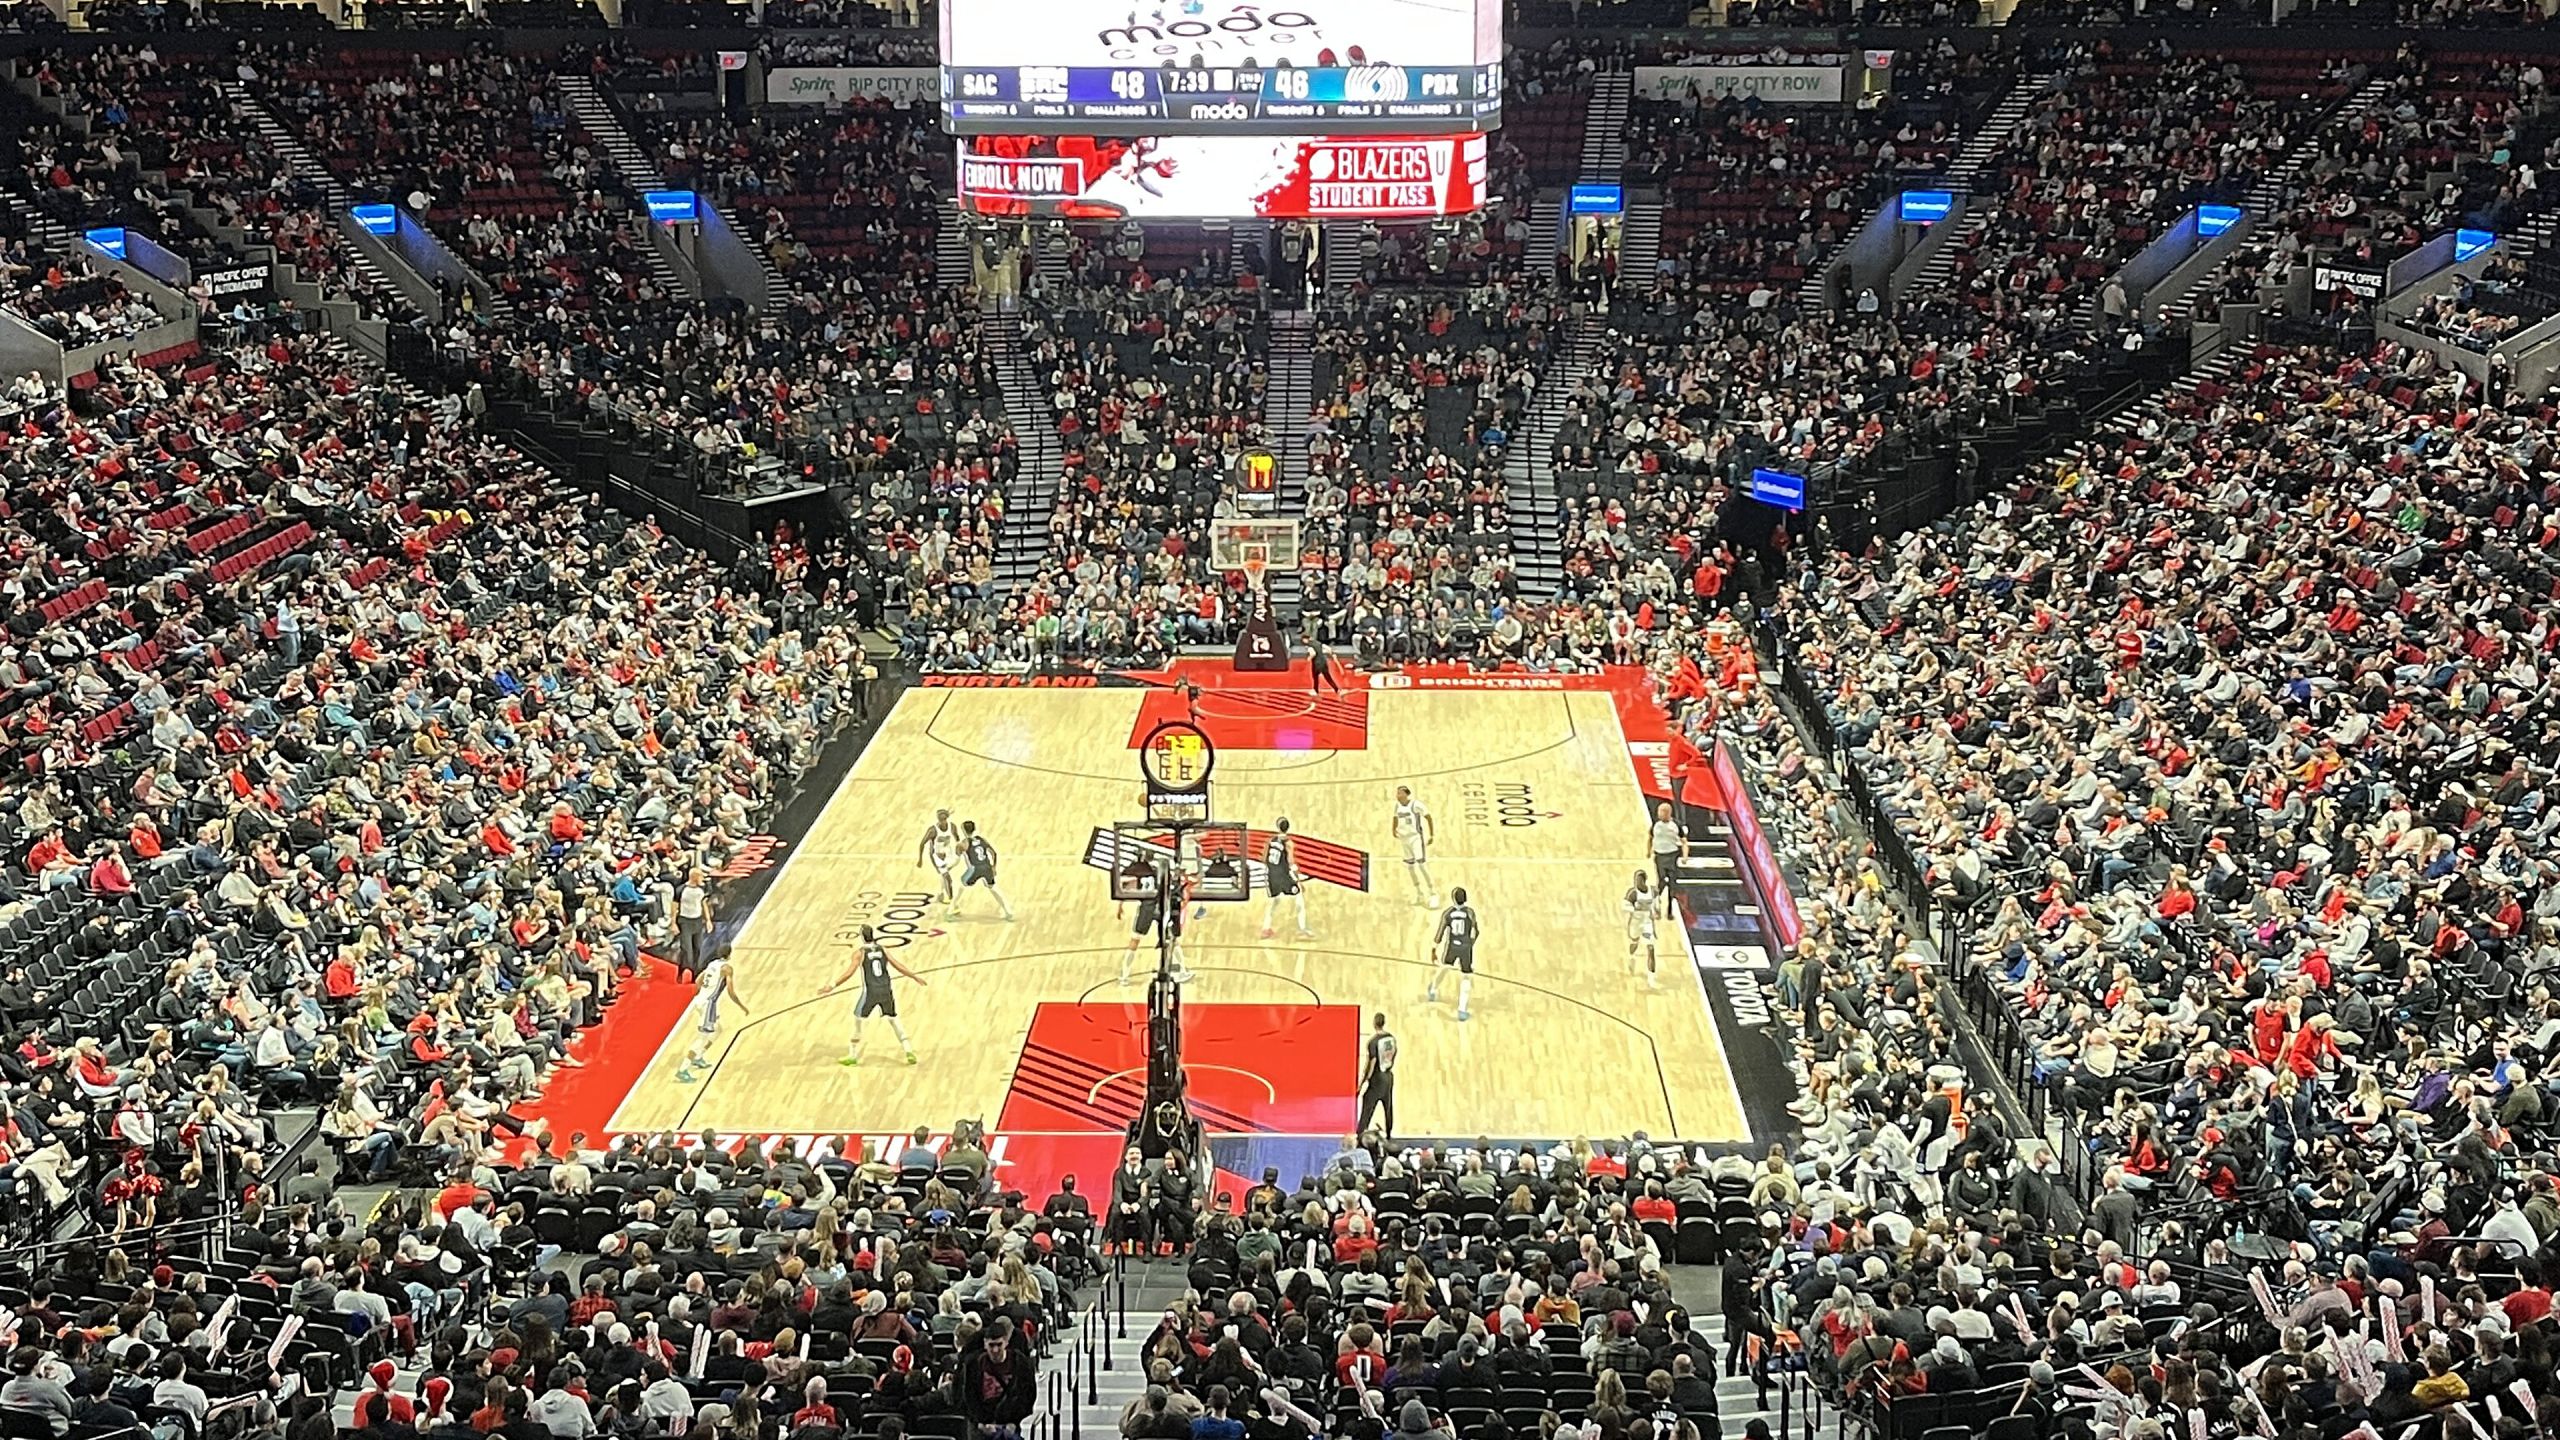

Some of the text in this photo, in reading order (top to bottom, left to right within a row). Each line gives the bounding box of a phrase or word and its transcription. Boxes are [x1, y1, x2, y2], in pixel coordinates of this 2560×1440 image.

[1098, 10, 1317, 46] moda
[850, 78, 873, 91] RIP
[877, 78, 912, 91] CITY
[963, 73, 998, 96] SAC
[1111, 70, 1145, 99] 48
[1169, 70, 1209, 92] 7:39
[1275, 70, 1309, 99] 46
[1714, 76, 1821, 91] RIP CITY ROW
[1190, 102, 1248, 120] moda
[1337, 147, 1427, 180] BLAZERS
[1435, 149, 1446, 176] U
[1017, 164, 1064, 192] NOW
[1309, 185, 1427, 207] STUDENT PASS
[1462, 782, 1490, 827] center
[1494, 782, 1546, 827] moda
[874, 891, 936, 948] moda
[1721, 970, 1772, 1026] TOYOTA
